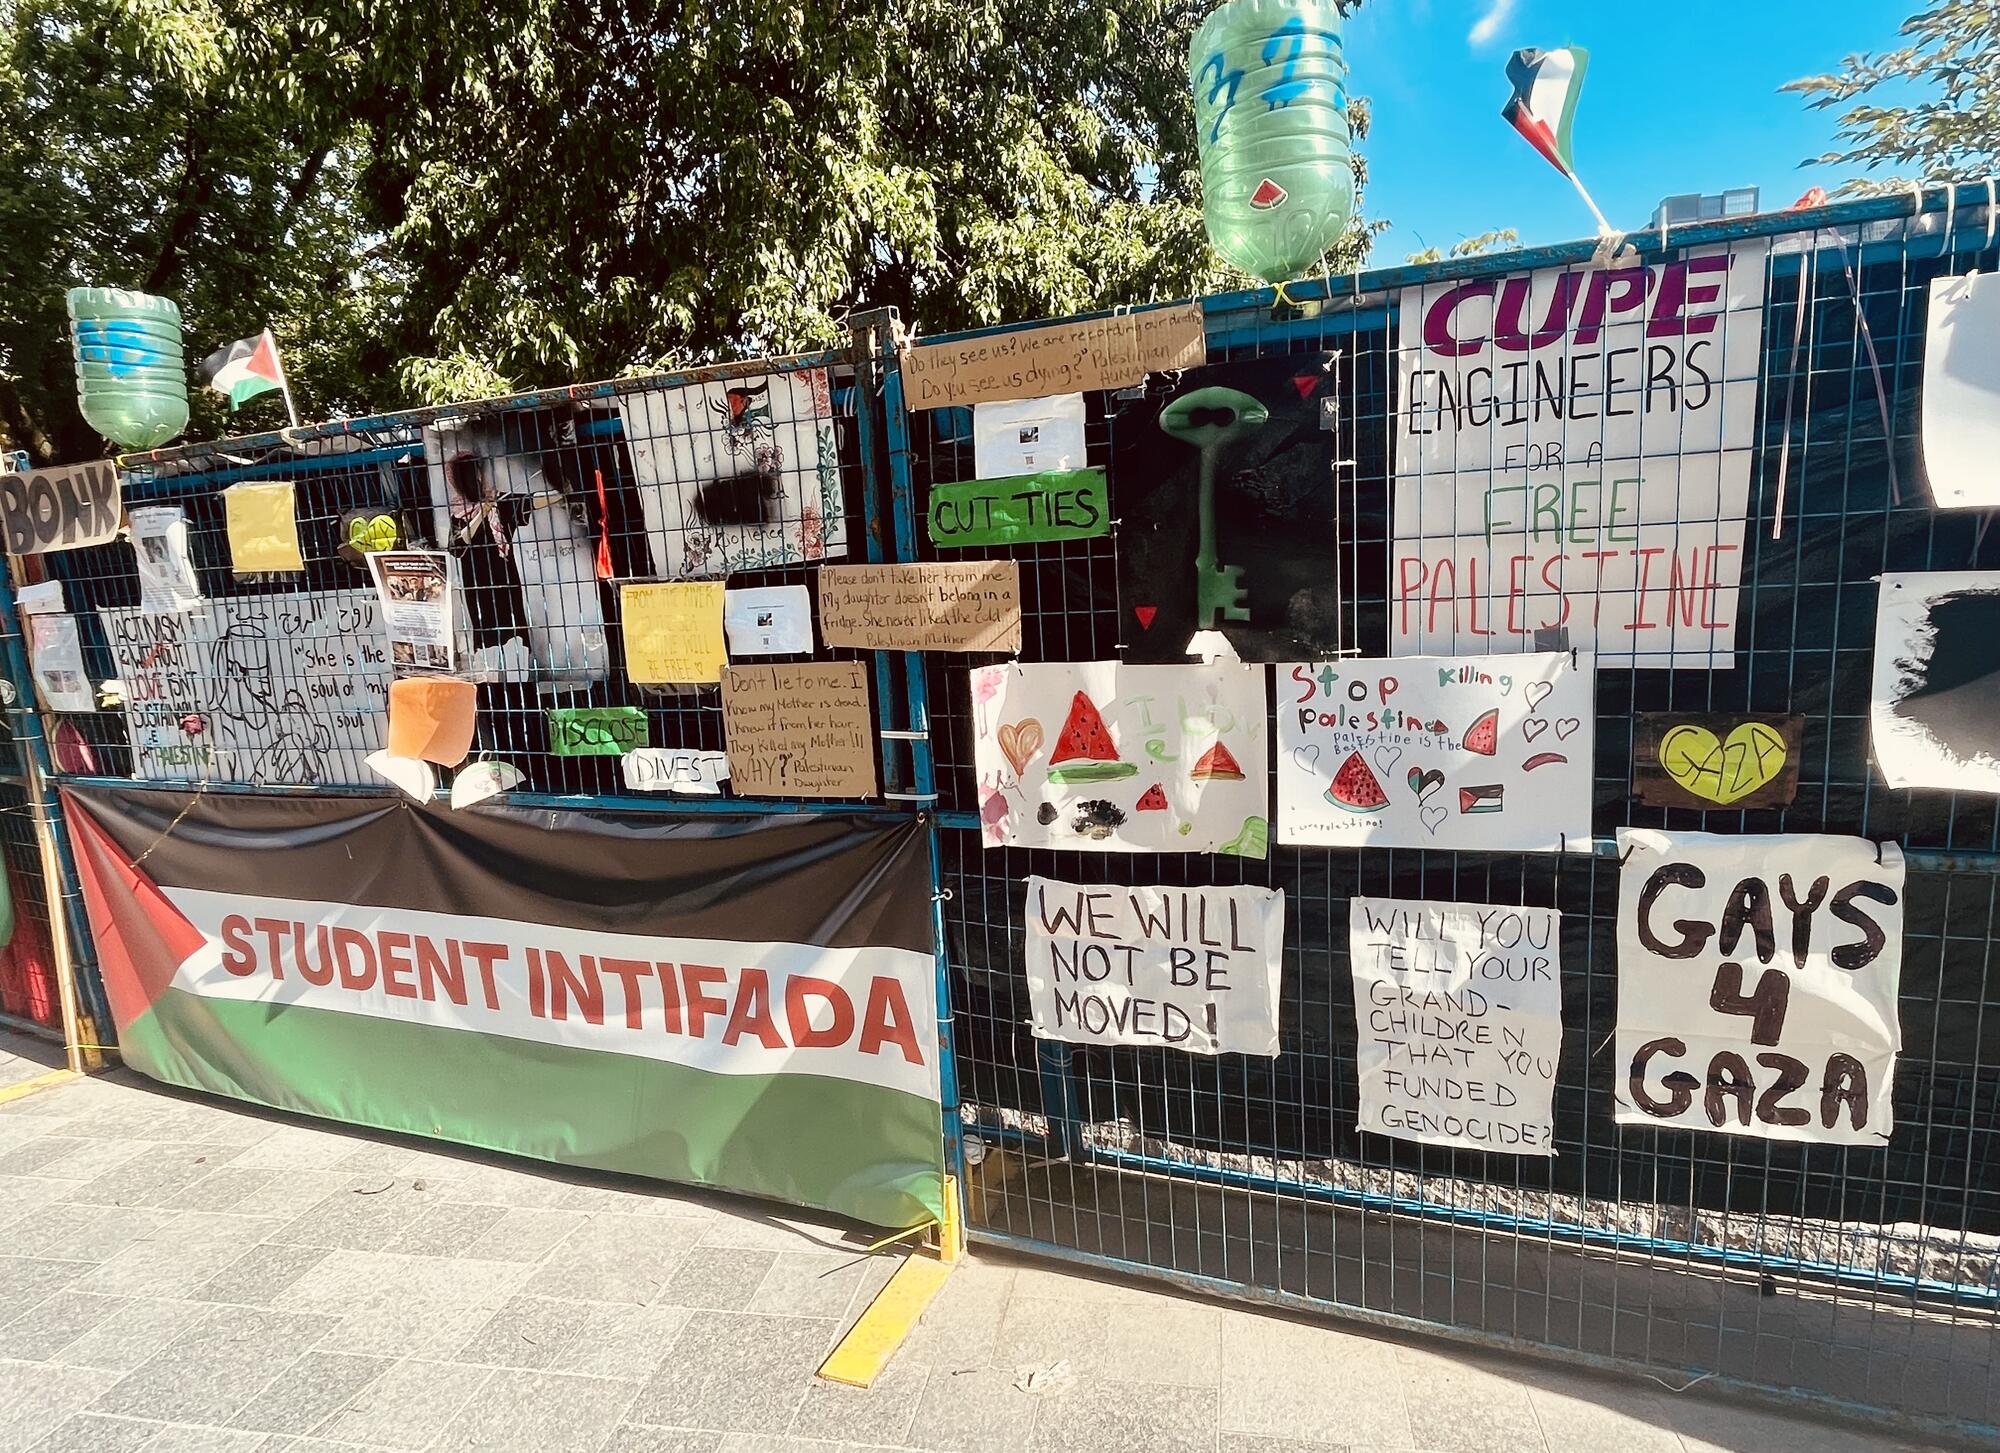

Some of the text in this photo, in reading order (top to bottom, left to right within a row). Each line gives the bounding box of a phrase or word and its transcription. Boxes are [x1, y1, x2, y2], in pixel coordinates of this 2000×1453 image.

[1423, 254, 1736, 357] CUPE
[960, 347, 989, 365] see
[992, 336, 1017, 357] us?
[1020, 337, 1041, 353] We
[1044, 334, 1064, 347] are
[1070, 321, 1142, 343] recording
[1144, 318, 1167, 330] our
[921, 378, 941, 400] Do
[970, 375, 1000, 393] see
[1003, 372, 1023, 388] us
[1408, 340, 1712, 435] ENGINEERS
[1504, 440, 1604, 474] FOR A
[0, 464, 116, 554] BONK
[934, 488, 1099, 534] CUT TIES
[1484, 477, 1647, 548] FREE
[919, 566, 940, 583] her
[1399, 544, 1739, 637] PALESTINE
[823, 592, 840, 611] My
[939, 586, 983, 611] belong
[984, 592, 998, 600] in
[1002, 592, 1011, 600] a
[862, 611, 886, 628] She
[362, 645, 386, 664] the
[128, 672, 167, 701] LOVE
[311, 682, 339, 698] soul
[771, 667, 793, 691] lie
[797, 668, 814, 689] to
[817, 677, 847, 689] me.
[849, 672, 863, 689] I
[1292, 664, 1513, 706] Stop Killing
[337, 714, 365, 729] soul
[819, 700, 831, 709] is
[1298, 703, 1438, 734] palestine
[550, 715, 647, 747] DISCLOSE
[767, 718, 777, 731] it
[1418, 734, 1432, 748] is
[1437, 736, 1463, 752] the
[635, 756, 724, 783] DIVEST
[1664, 727, 1786, 797] GAZA
[1038, 885, 1256, 954] WE WILL
[1365, 907, 1552, 950] WILL YOU
[1638, 863, 1898, 969] GAYS
[1050, 940, 1231, 991] NOT BE
[1367, 943, 1552, 981] TELL YOUR
[222, 914, 925, 1066] STUDENT INTIFADA
[1370, 980, 1511, 1017] GRAND-
[1710, 963, 1791, 1046] 4
[1054, 987, 1219, 1048] MOVED!
[1370, 1009, 1525, 1048] CHILDREN
[1374, 1038, 1553, 1080] THAT YOU
[1382, 1069, 1518, 1107] FUNDED
[1630, 1038, 1868, 1131] GAZA
[1381, 1104, 1552, 1149] GENOCIDE?
